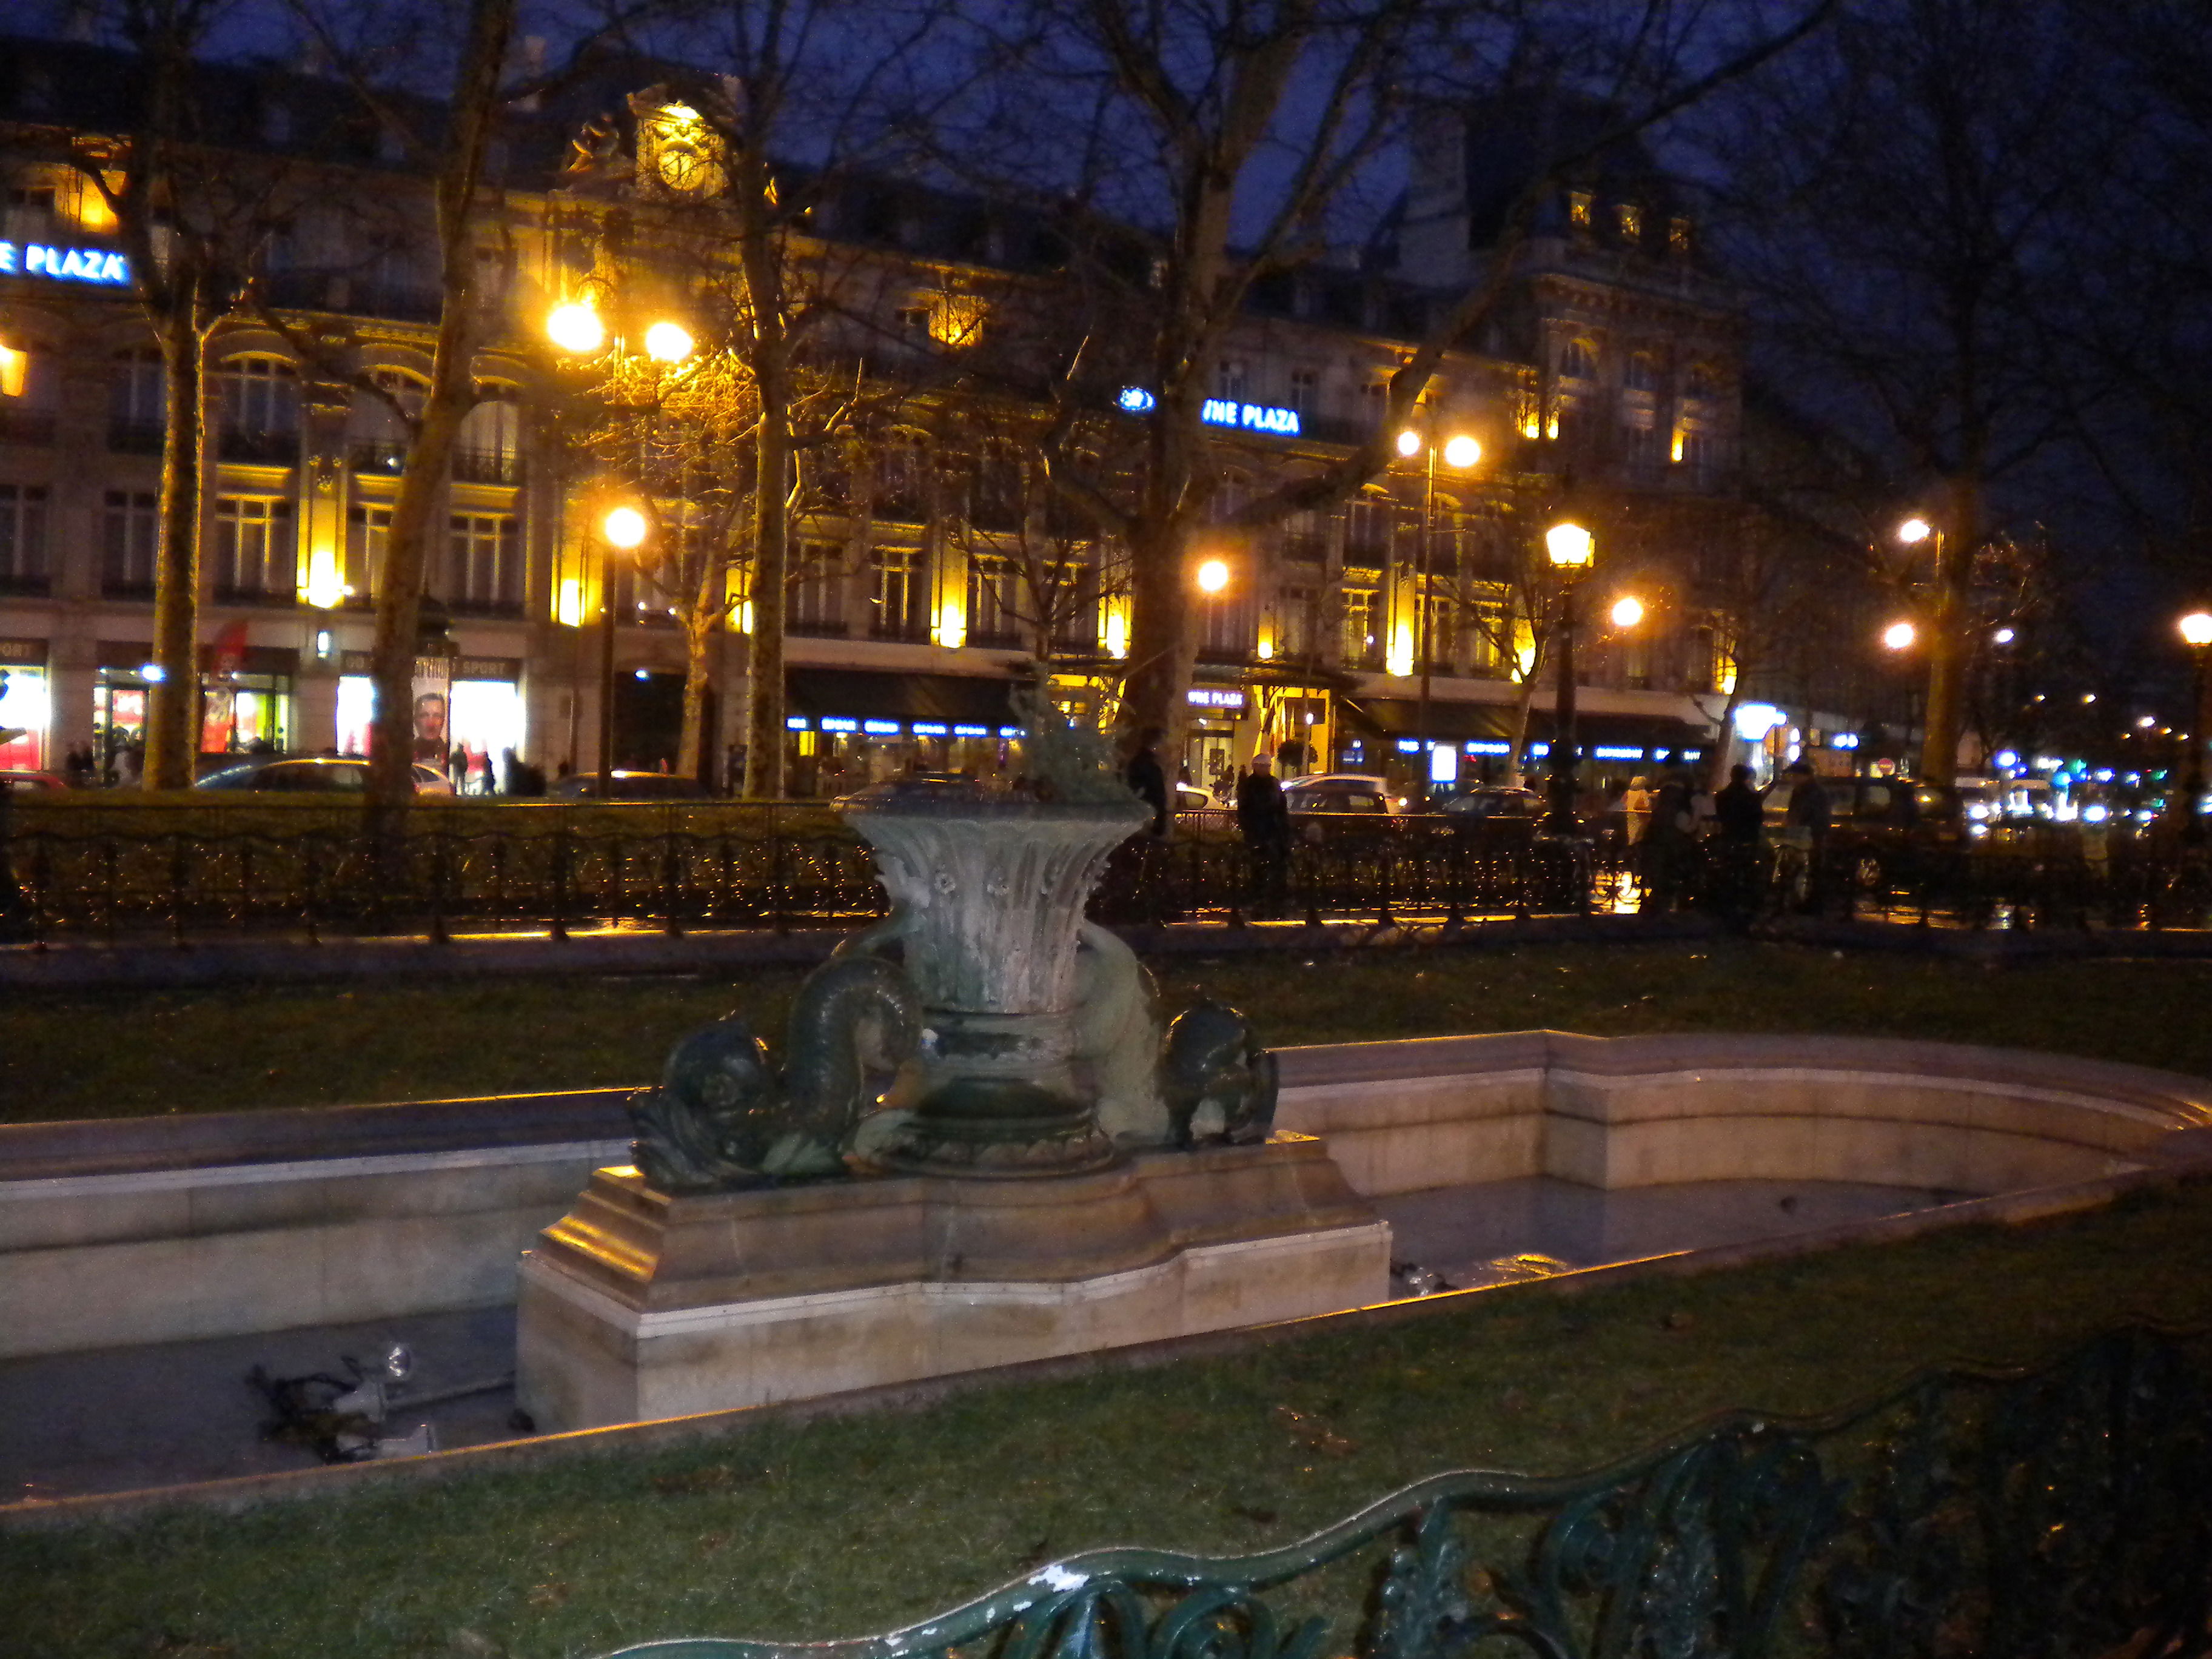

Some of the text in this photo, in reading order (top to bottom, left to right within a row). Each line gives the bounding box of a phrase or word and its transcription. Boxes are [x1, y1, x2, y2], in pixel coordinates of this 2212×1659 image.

[26, 244, 125, 281] PLAZA
[1244, 404, 1299, 434] PLAZA
[463, 660, 505, 675] SPORT
[1212, 691, 1243, 705] PLAZA
